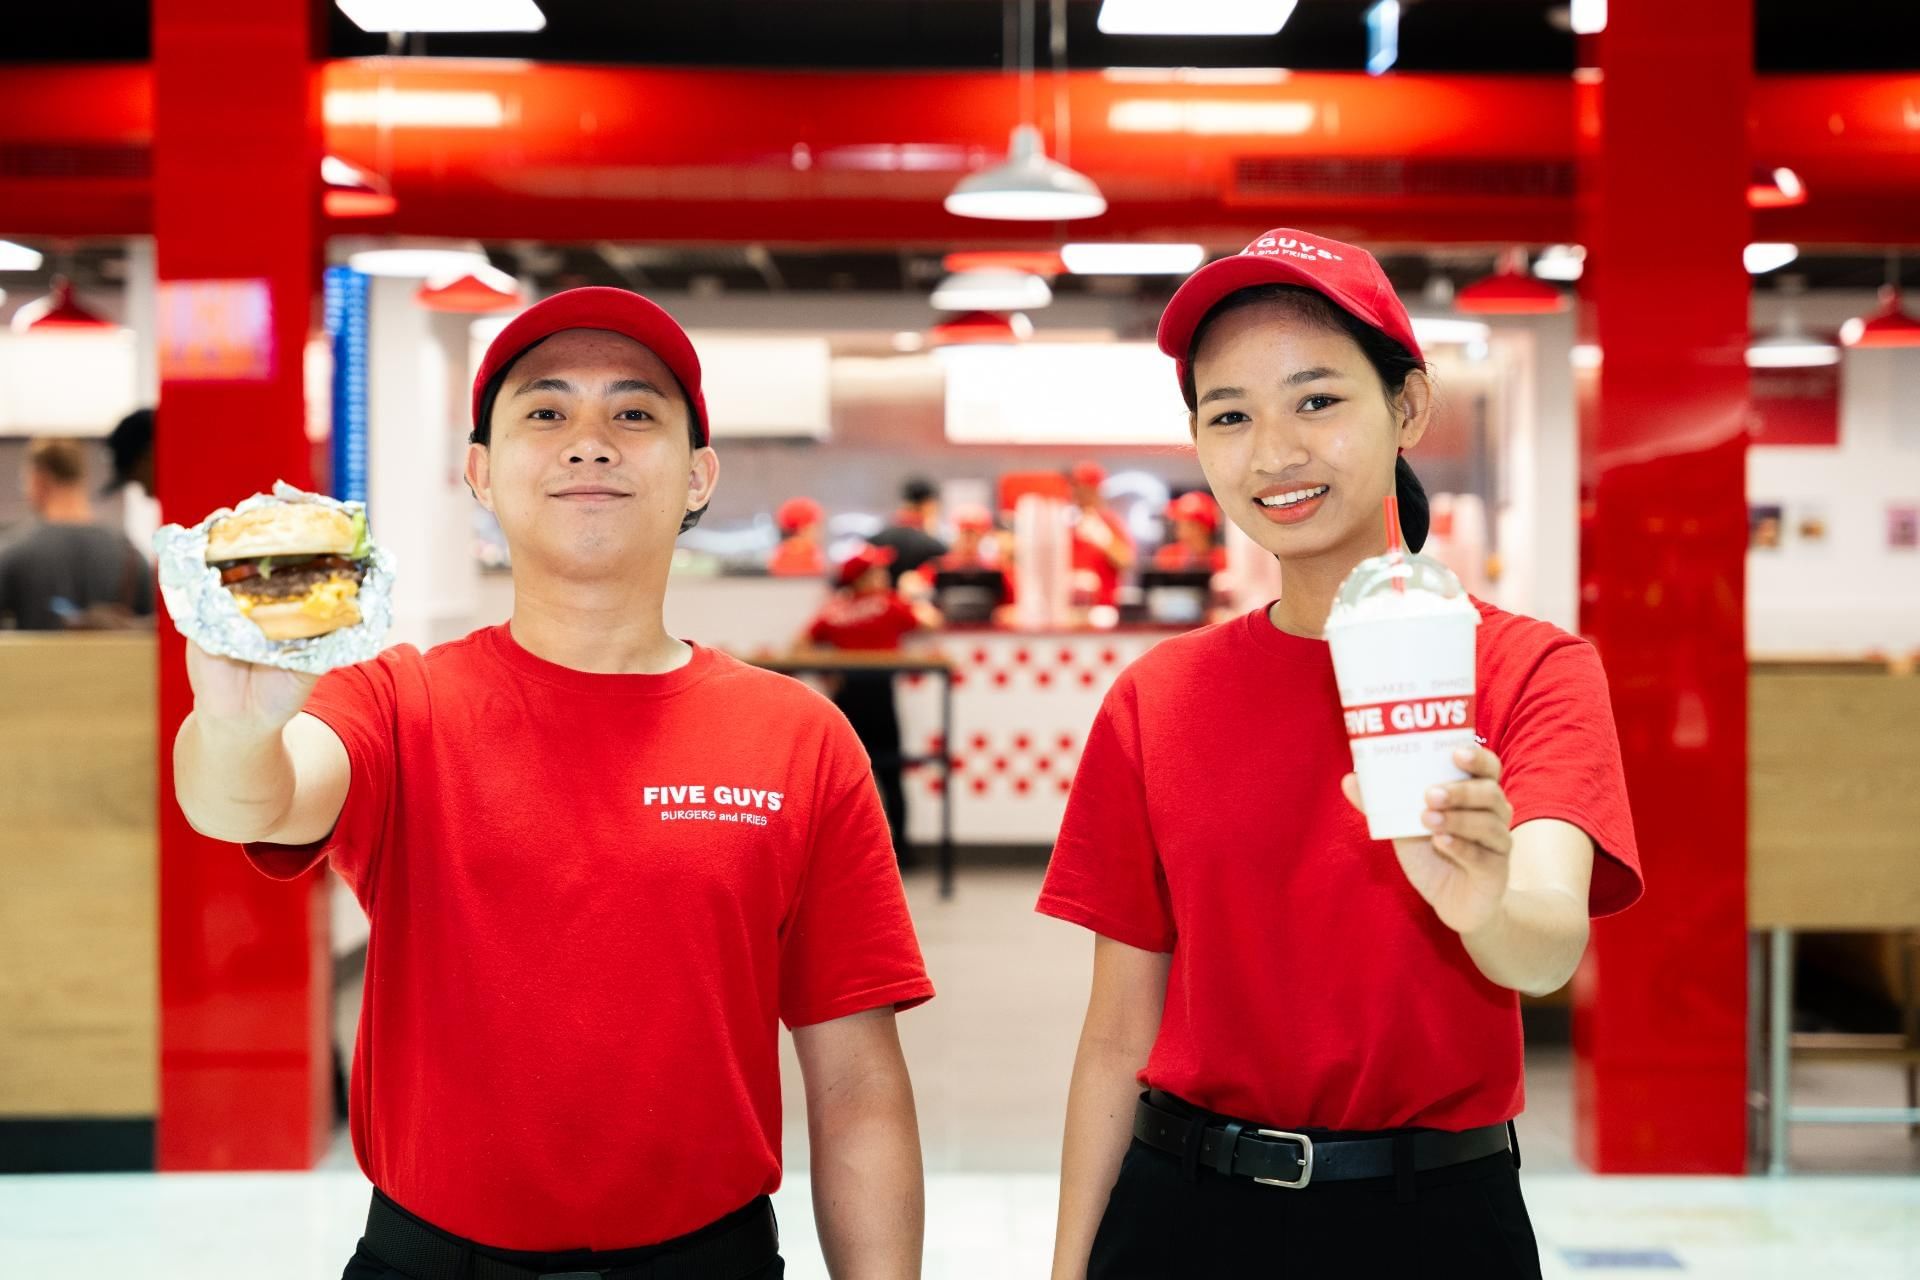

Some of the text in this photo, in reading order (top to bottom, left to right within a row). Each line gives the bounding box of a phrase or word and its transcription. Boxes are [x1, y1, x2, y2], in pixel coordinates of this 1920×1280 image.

[1257, 237, 1333, 260] GUYS
[1391, 700, 1467, 730] GUYS
[643, 785, 782, 811] FIVE GUYS
[660, 810, 768, 826] BURGERS and FRIES
